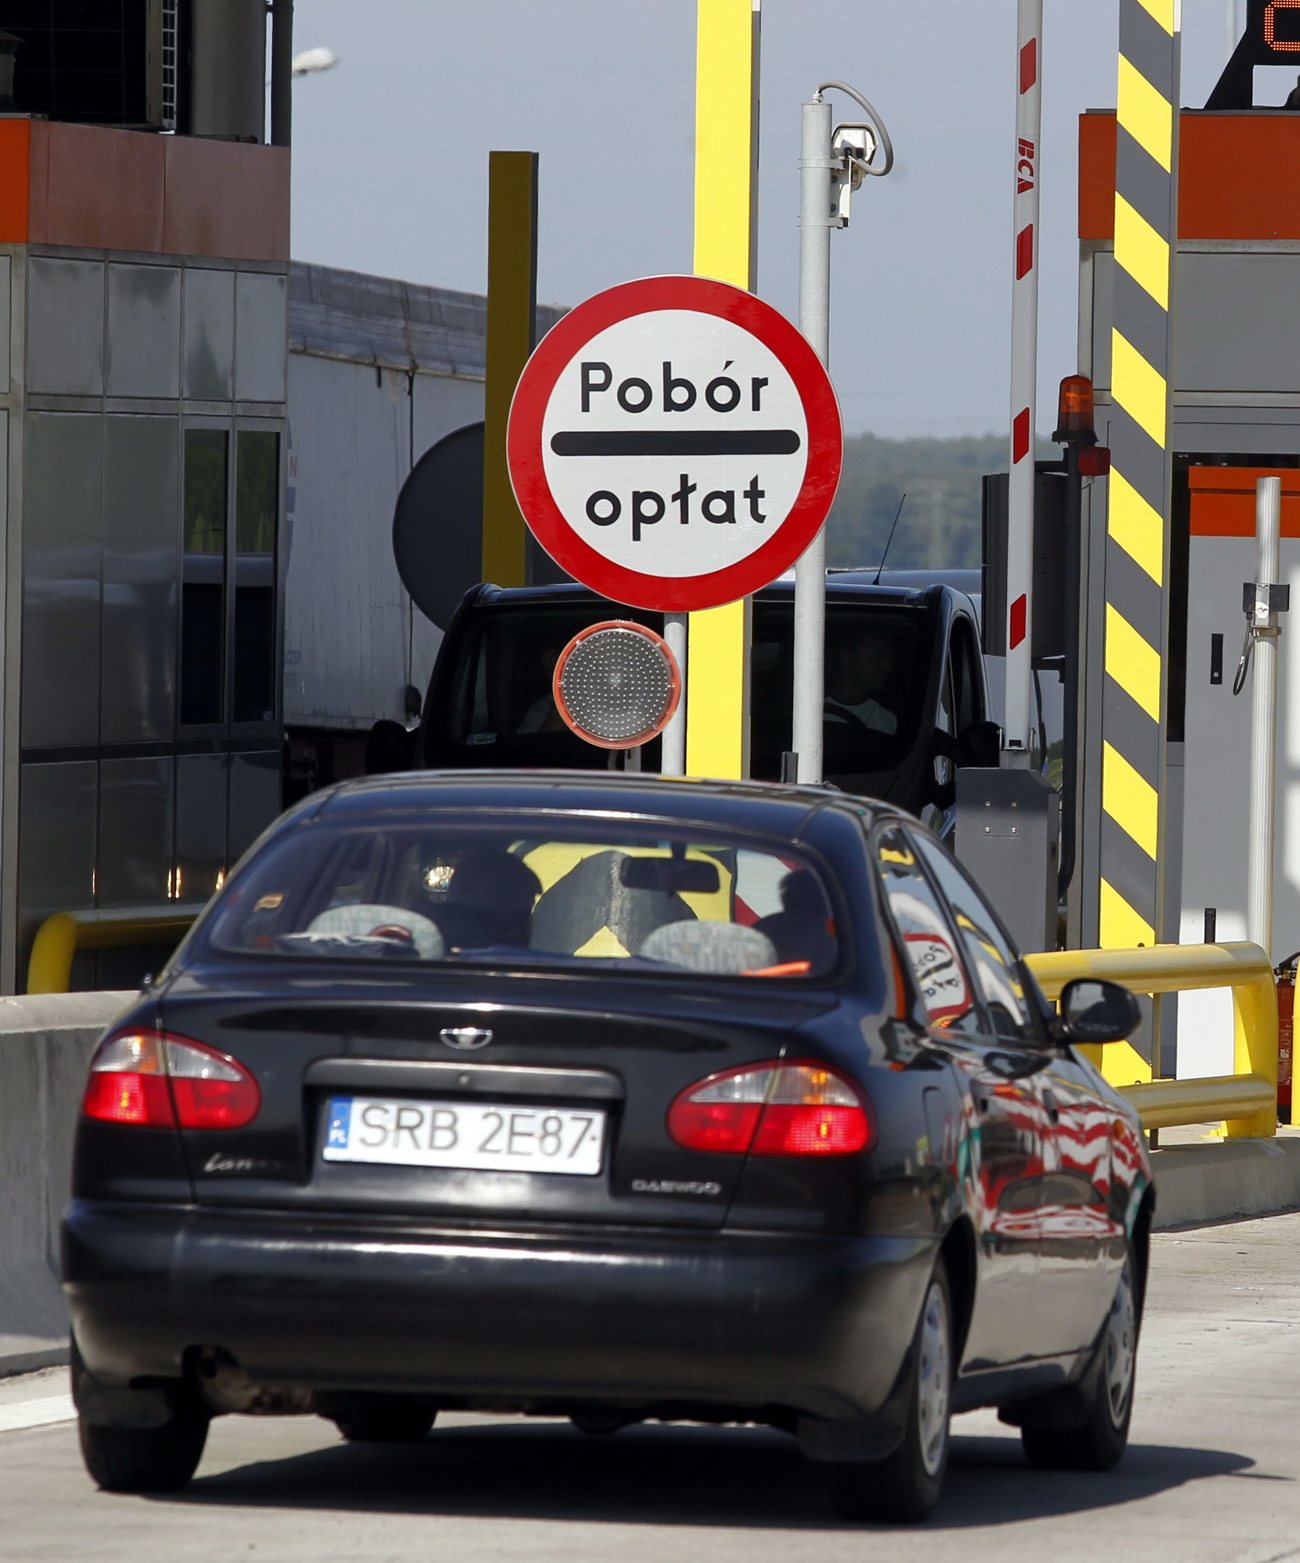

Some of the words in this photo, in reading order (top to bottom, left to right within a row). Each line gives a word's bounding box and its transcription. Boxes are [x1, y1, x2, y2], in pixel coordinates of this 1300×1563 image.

[1017, 137, 1035, 195] BCA
[580, 360, 769, 414] Pobór
[585, 473, 767, 541] opłat
[359, 1104, 459, 1152] SRB
[476, 1111, 595, 1160] 2E87
[631, 1178, 722, 1196] DAEWOO
